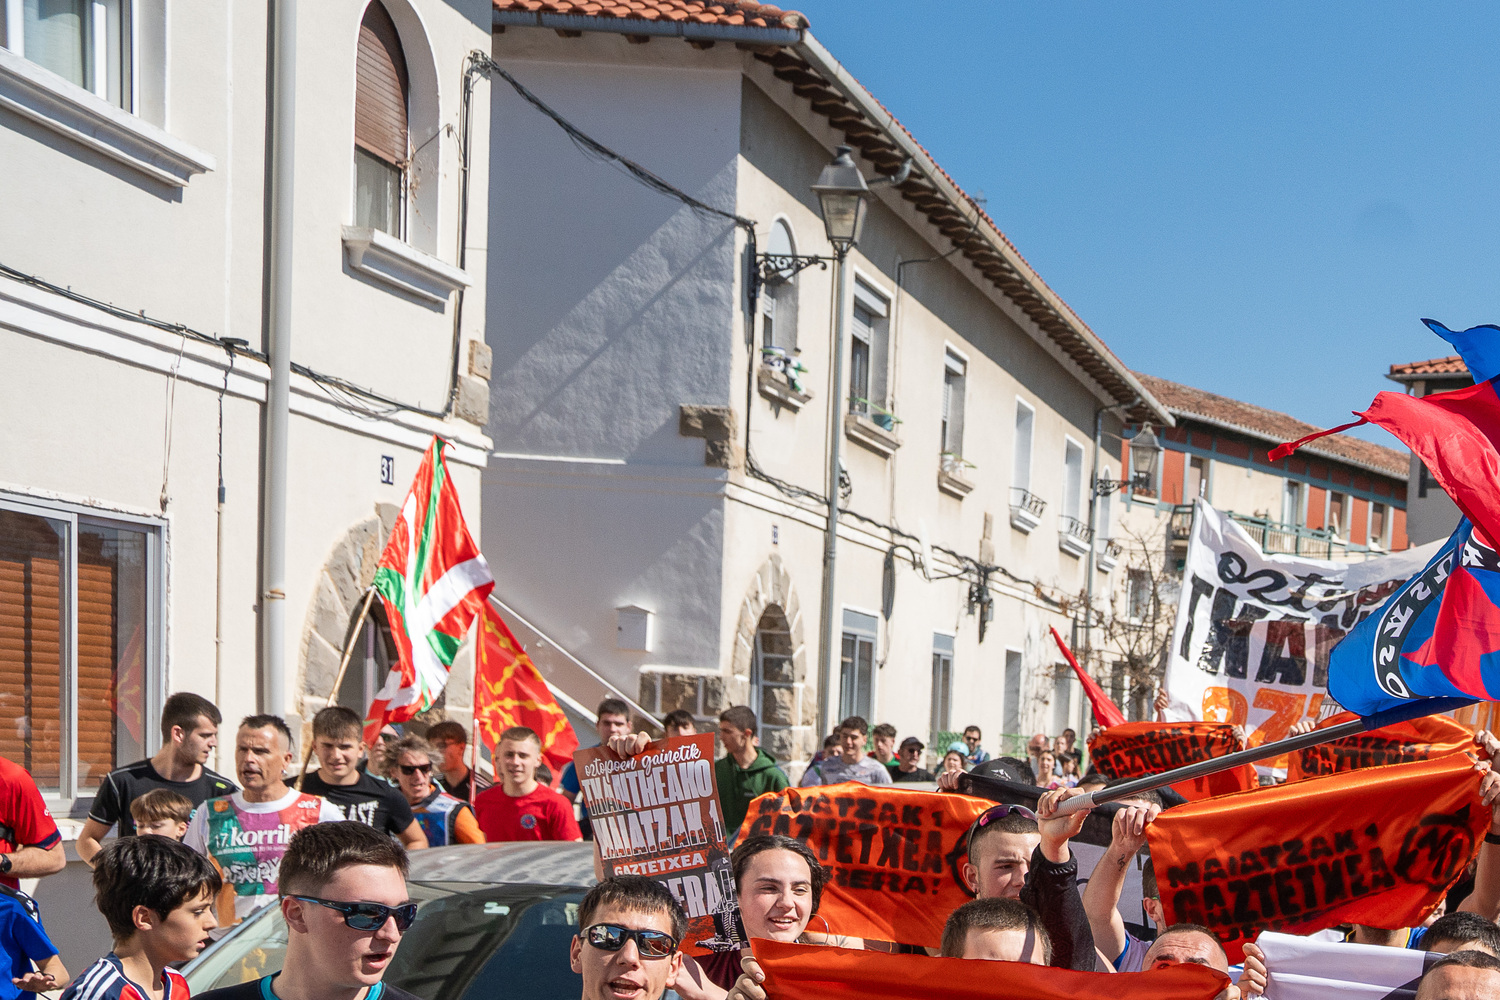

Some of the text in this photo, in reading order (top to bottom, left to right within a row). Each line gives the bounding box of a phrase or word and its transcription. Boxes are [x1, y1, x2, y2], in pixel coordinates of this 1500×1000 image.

[381, 457, 393, 483] 31
[641, 743, 702, 774] gainetik
[614, 852, 706, 876] GAZTETXEA
[1168, 829, 1358, 888] MAIATZAK
[1173, 847, 1396, 926] GAZTETXEA
